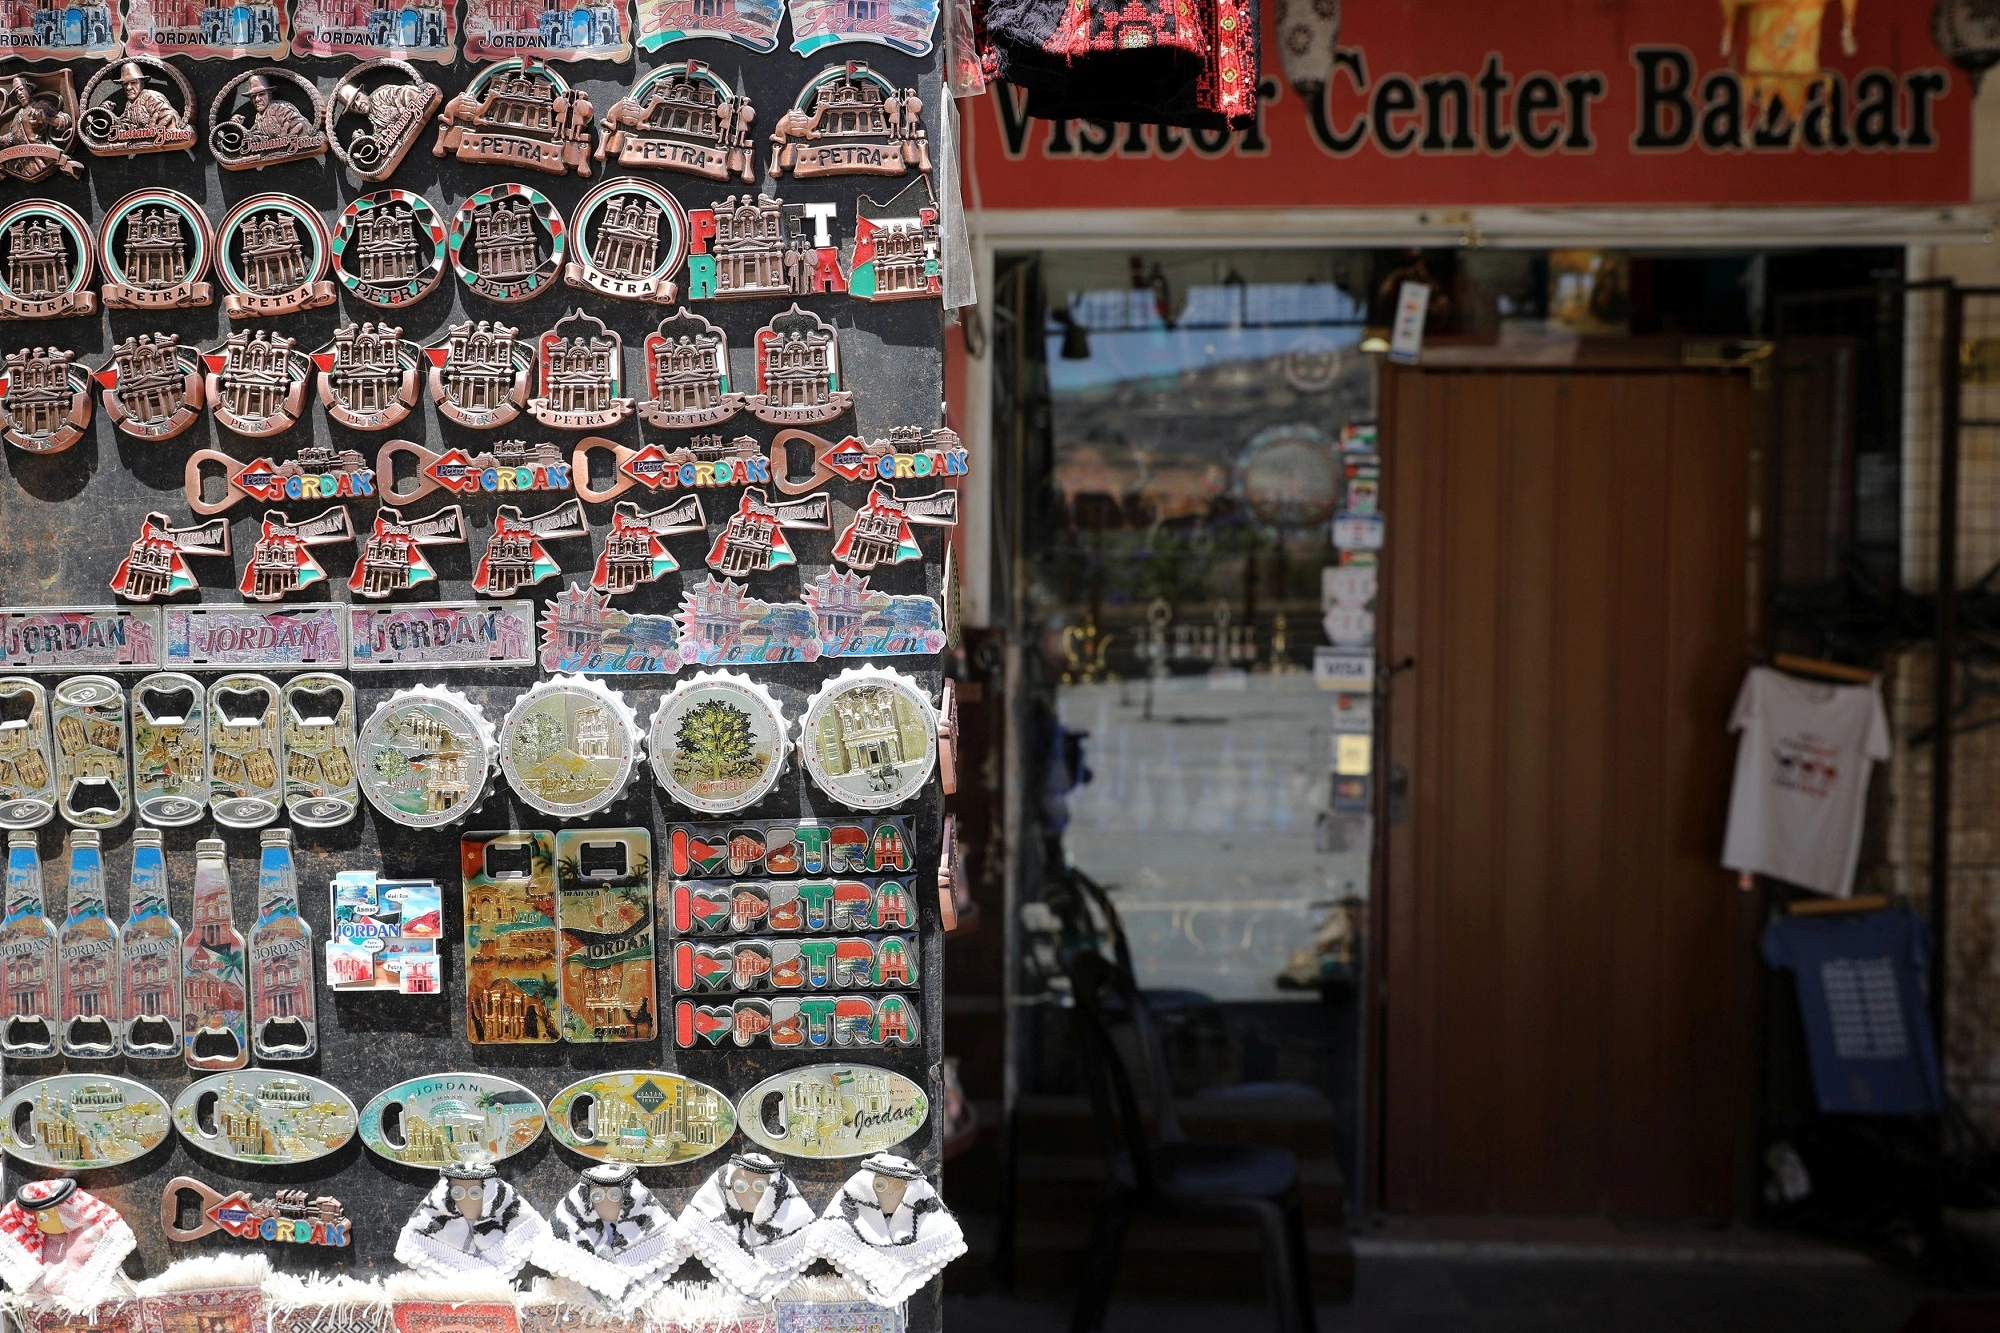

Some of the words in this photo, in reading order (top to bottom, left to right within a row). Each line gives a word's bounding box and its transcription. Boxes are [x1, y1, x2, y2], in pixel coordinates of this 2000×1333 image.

[642, 0, 767, 39] Jordan
[794, 1, 921, 42] Jordan
[141, 27, 209, 46] JORDAN
[307, 25, 377, 46] JORDAN
[478, 29, 549, 48] JORDAN
[1308, 52, 1603, 152] Center
[107, 125, 155, 142] Indiana
[153, 125, 191, 146] Jones
[240, 136, 288, 155] Indiana
[286, 134, 323, 156] Jones
[480, 137, 541, 163] PETRA
[643, 142, 705, 168] PETRA
[818, 148, 883, 168] PETRA
[124, 287, 187, 302] PETRA
[353, 278, 430, 302] PETRA
[471, 274, 549, 299] PETRA
[588, 271, 652, 294] PETRA
[9, 296, 71, 313] PETRA
[247, 287, 310, 308] PETRA
[229, 419, 273, 433] PETRA
[346, 411, 390, 426] PETRA
[455, 411, 499, 426] PETRA
[553, 414, 606, 426] PETRA
[666, 412, 717, 425] PETRA
[773, 408, 825, 421] PETRA
[137, 420, 178, 436] PETRA
[20, 435, 61, 450] PETRA
[661, 459, 770, 487] JORDAN
[859, 452, 968, 479] JORDAN
[268, 471, 375, 500] JORDAN
[464, 466, 570, 492] JORDAN
[620, 516, 649, 531] Petra
[648, 503, 696, 532] JORDAN
[773, 502, 824, 522] JORDAN
[902, 498, 953, 519] JORDAN
[269, 524, 297, 538] Petra
[299, 514, 344, 544] JORDAN
[382, 521, 409, 536] Petra
[408, 515, 456, 542] JORDAN
[503, 519, 530, 533] Petra
[530, 506, 579, 537] JORDAN
[148, 528, 175, 541] Petra
[174, 528, 223, 547] JORDAN
[7, 618, 126, 656] JORDAN
[200, 621, 319, 653] JORDAN
[372, 613, 497, 653] JORDAN
[827, 623, 918, 657] Jordan
[567, 639, 658, 673] Jordan
[706, 630, 797, 666] Jordan
[727, 825, 914, 876] PETRA
[730, 880, 917, 932] PETRA
[337, 924, 401, 938] JORDAN
[62, 939, 114, 960] JORDAN
[124, 938, 176, 958] JORDAN
[254, 938, 307, 961] JORDAN
[585, 933, 650, 960] JORDAN
[732, 935, 920, 991] PETRA
[732, 994, 920, 1046] PETRA
[416, 1083, 478, 1096] JORDAN
[855, 1104, 915, 1139] Jordan
[242, 1214, 346, 1248] JORDAN
